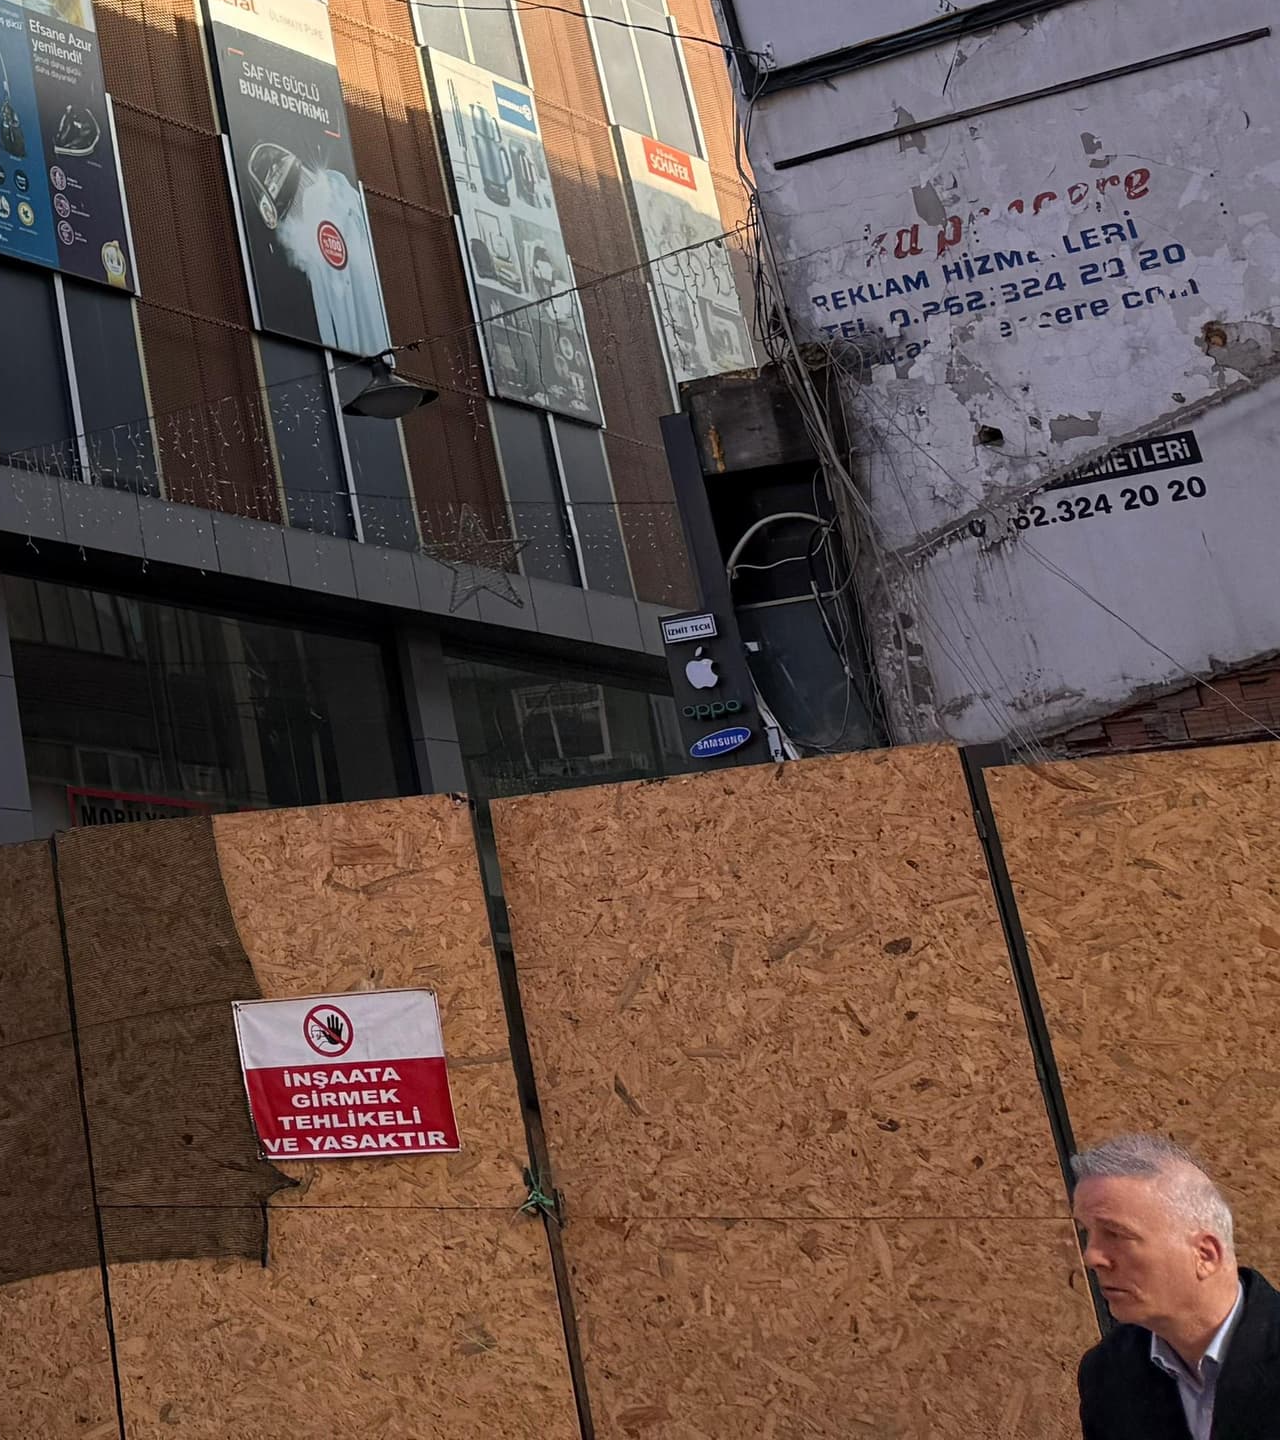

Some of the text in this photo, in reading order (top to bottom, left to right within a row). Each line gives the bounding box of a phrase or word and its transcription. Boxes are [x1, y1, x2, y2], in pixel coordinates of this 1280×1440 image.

[29, 19, 92, 53] Efsane Azur
[32, 38, 83, 65] yenilendi!
[242, 61, 320, 102] SAF VE GÜÇLÜ
[238, 78, 330, 124] BUHAR DEVRİMİ!
[813, 210, 1139, 312] REKLAM HİZMLERİ
[1140, 243, 1187, 271] 20
[1120, 484, 1160, 511] 20
[1167, 475, 1208, 502] 20
[682, 699, 741, 720] oppo
[696, 734, 744, 751] SAMSUNG
[283, 1067, 401, 1089] İNŞAATA
[291, 1088, 400, 1109] GİRMEK
[277, 1106, 422, 1131] TEHLİKELİ
[262, 1131, 448, 1153] VE YASAKTIR
